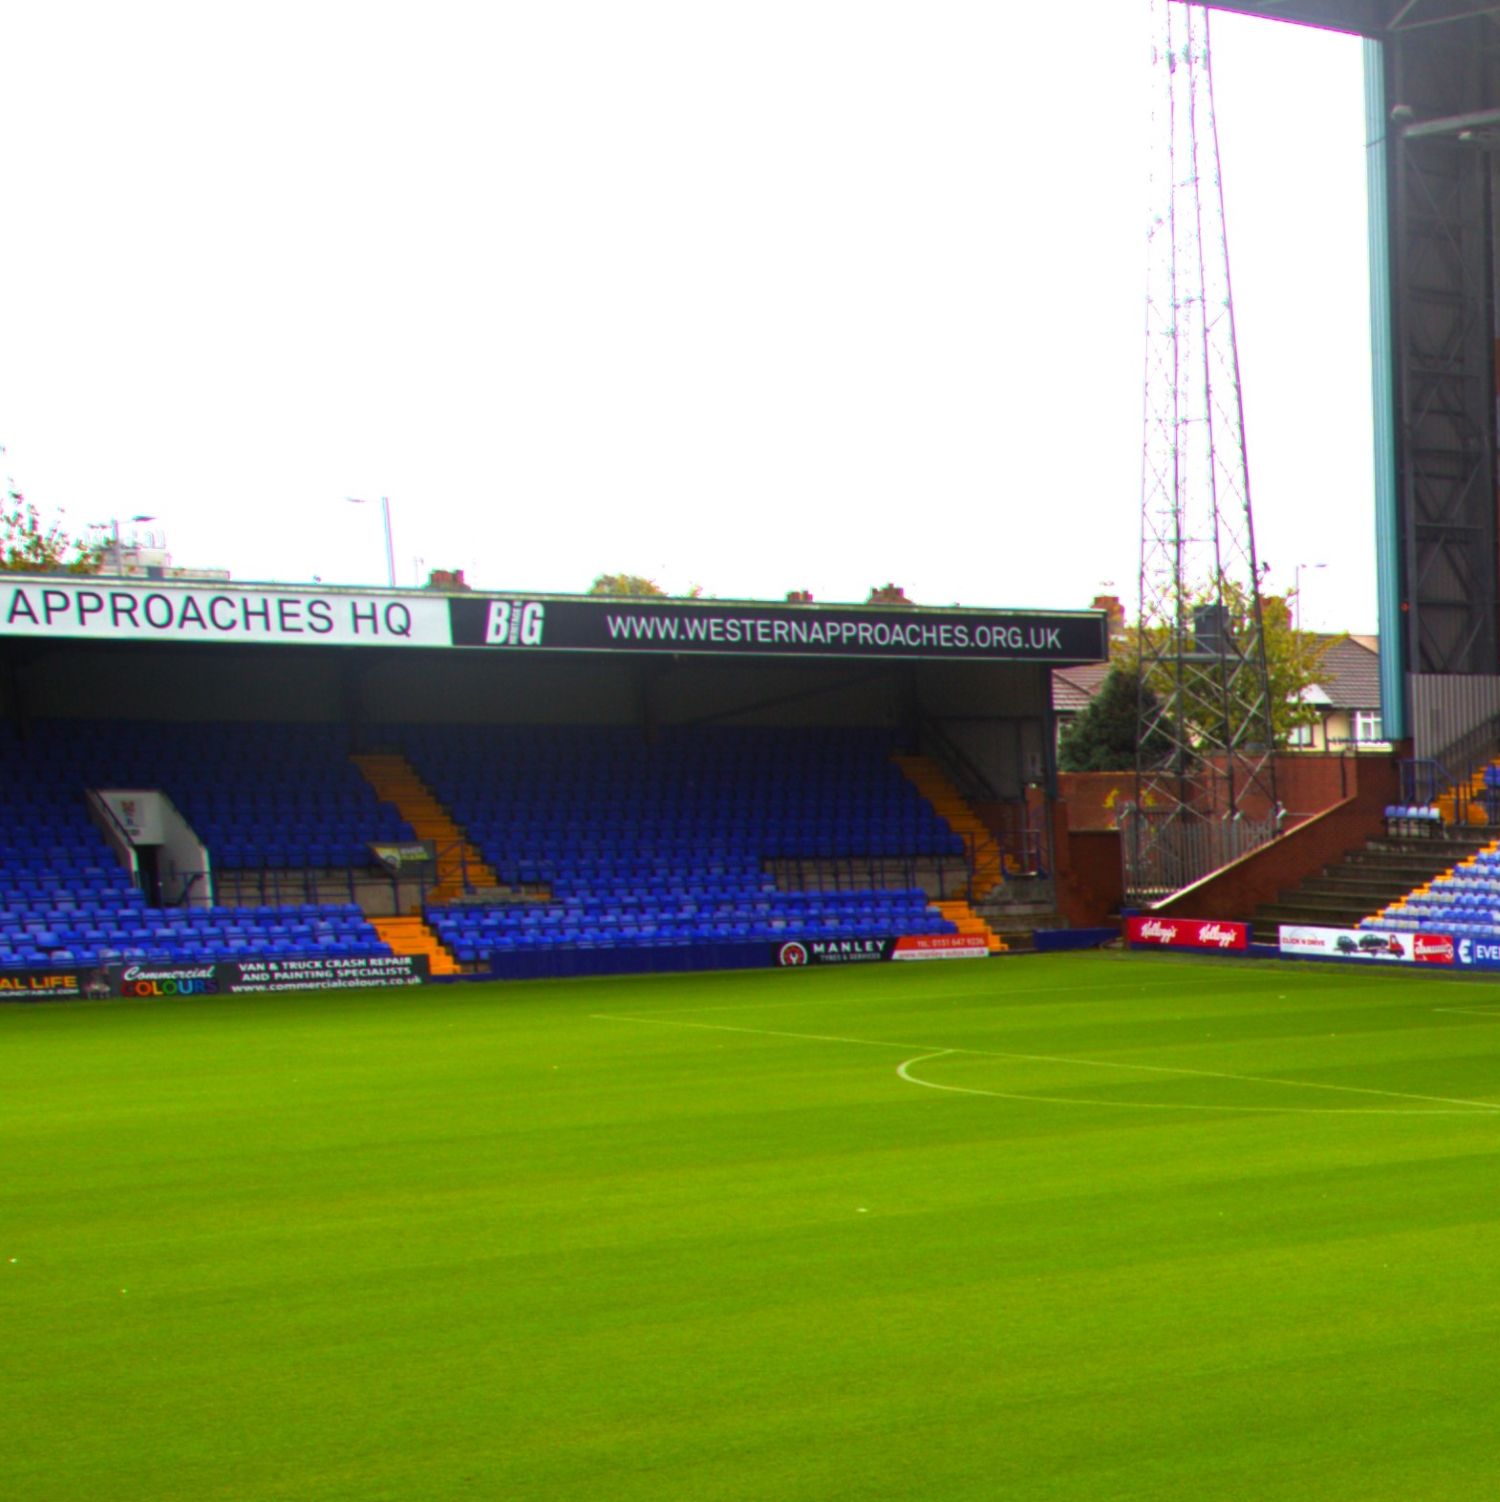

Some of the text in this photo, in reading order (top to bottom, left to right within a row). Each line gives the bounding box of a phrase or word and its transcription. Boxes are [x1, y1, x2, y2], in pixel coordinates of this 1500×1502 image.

[7, 588, 413, 638] APPROACHES HQ
[606, 614, 1063, 650] WWW.WESTERNAPPROACHES.ORG.UK
[1140, 920, 1177, 944] Kellogg's
[1198, 922, 1238, 946] Kellogg's
[813, 940, 886, 954] MANLEY
[123, 965, 216, 980] Commercial
[238, 956, 413, 972] VAN & TRUCK CRASH REPAIR
[29, 974, 78, 989] LIFE
[242, 967, 411, 982] AND PAINTING SPECIALISTS
[121, 979, 217, 997] COLOURS
